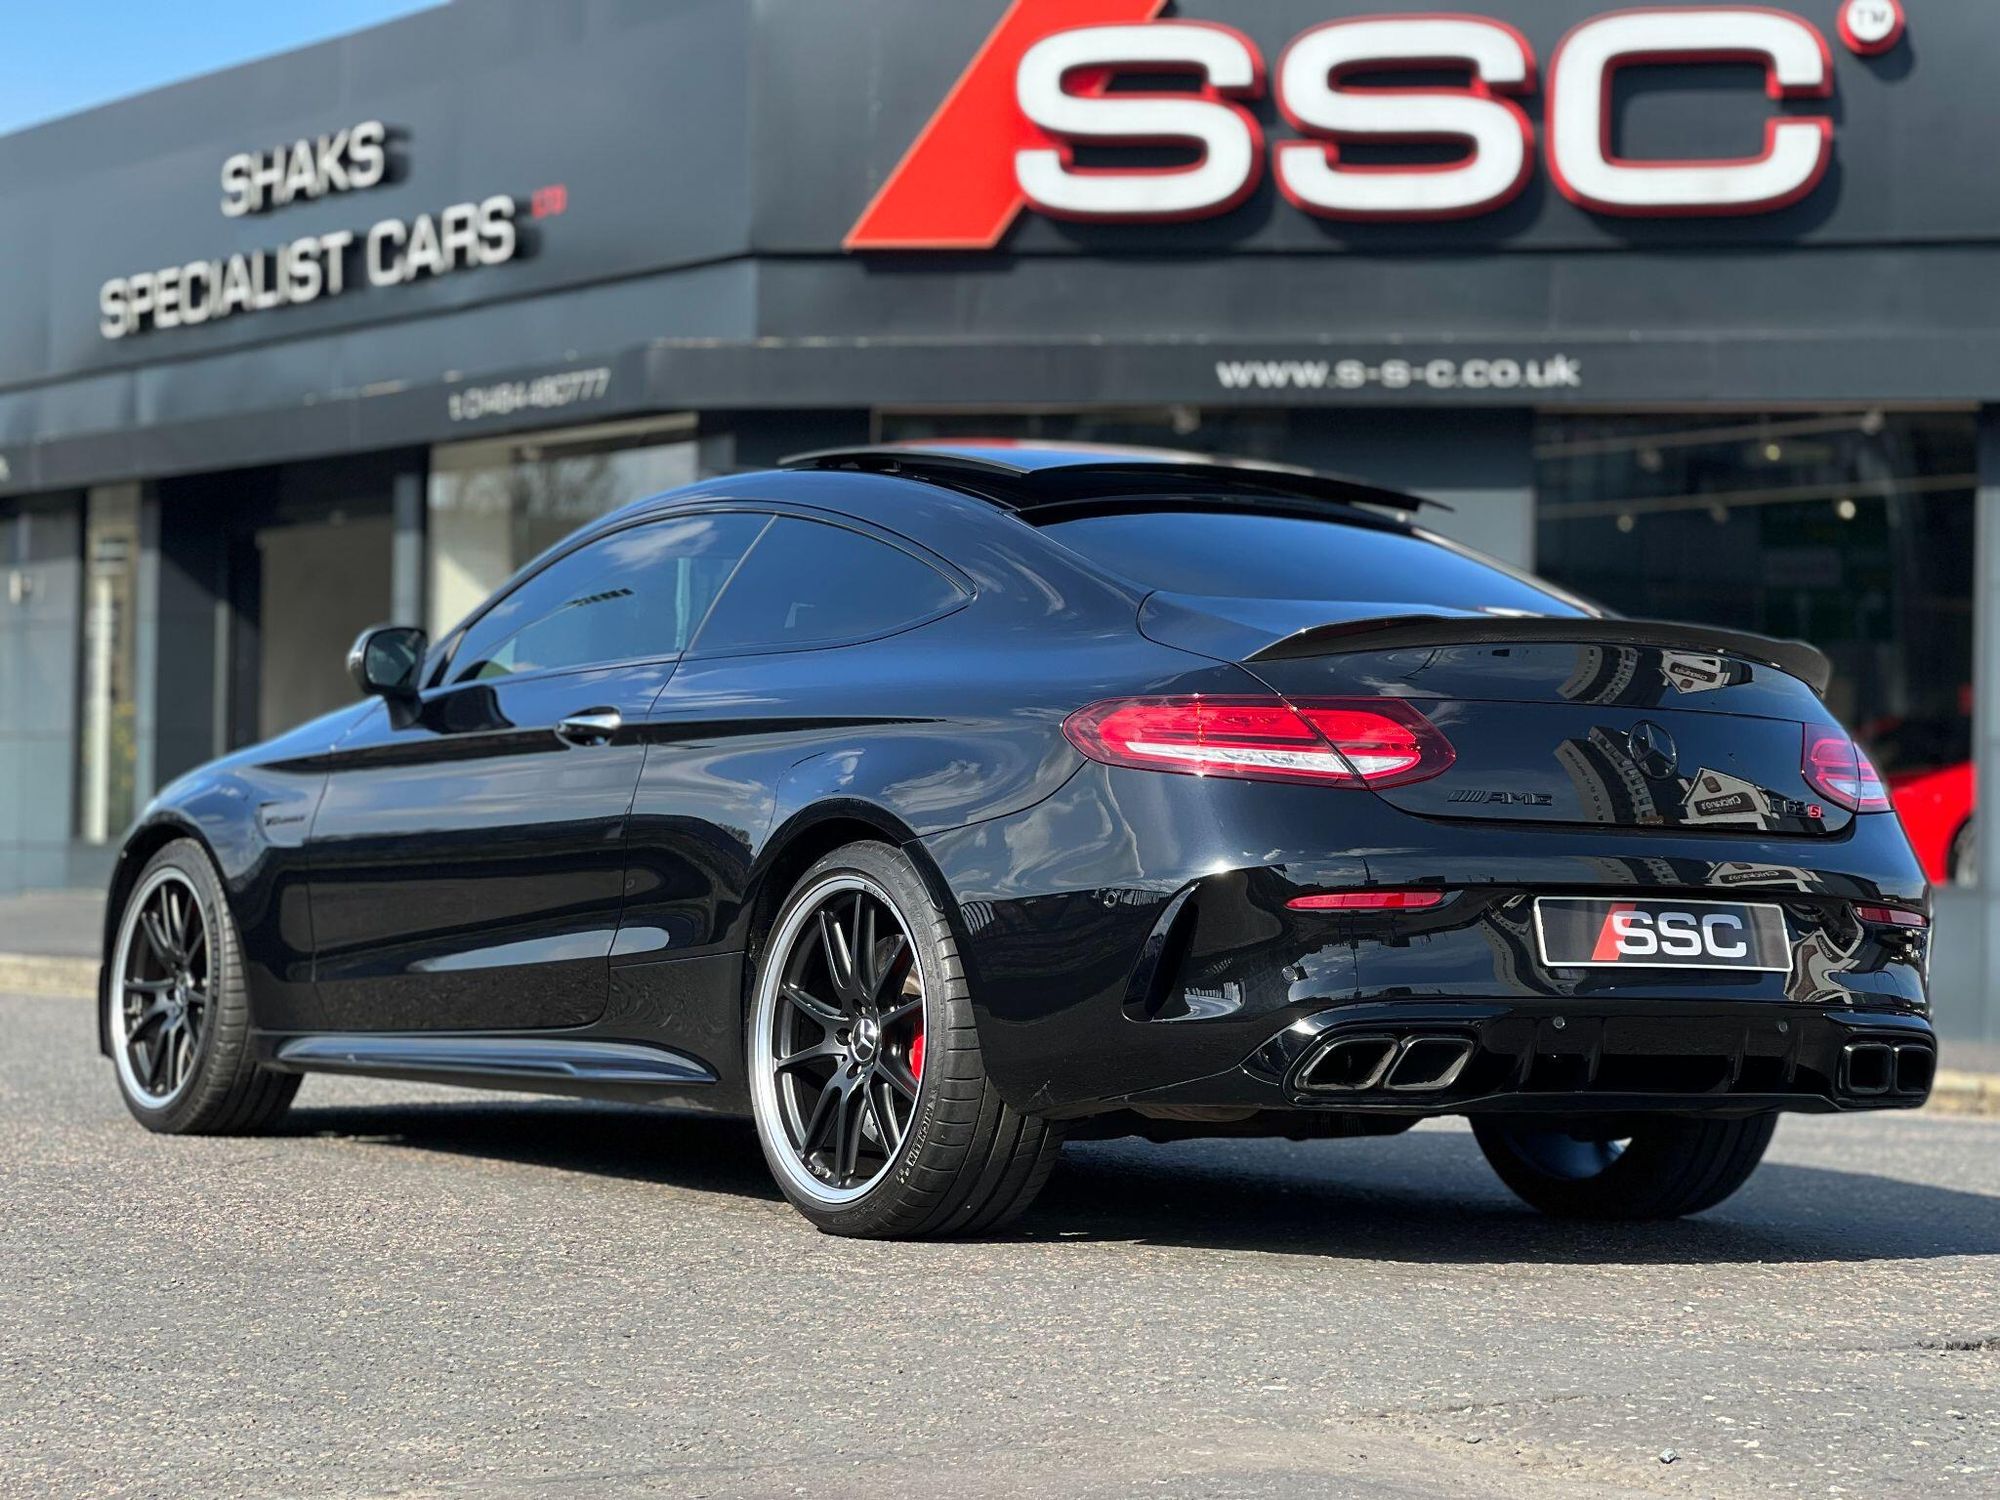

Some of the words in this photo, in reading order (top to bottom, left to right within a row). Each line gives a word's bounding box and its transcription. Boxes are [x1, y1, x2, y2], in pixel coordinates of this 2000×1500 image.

[1015, 10, 1830, 217] SSC
[220, 120, 385, 217] SHAKS
[100, 230, 352, 339] SPECIALIST
[367, 195, 516, 286] CARS
[1215, 353, 1581, 389] www.s-s-c.co.uk
[1612, 910, 1747, 958] SSC
